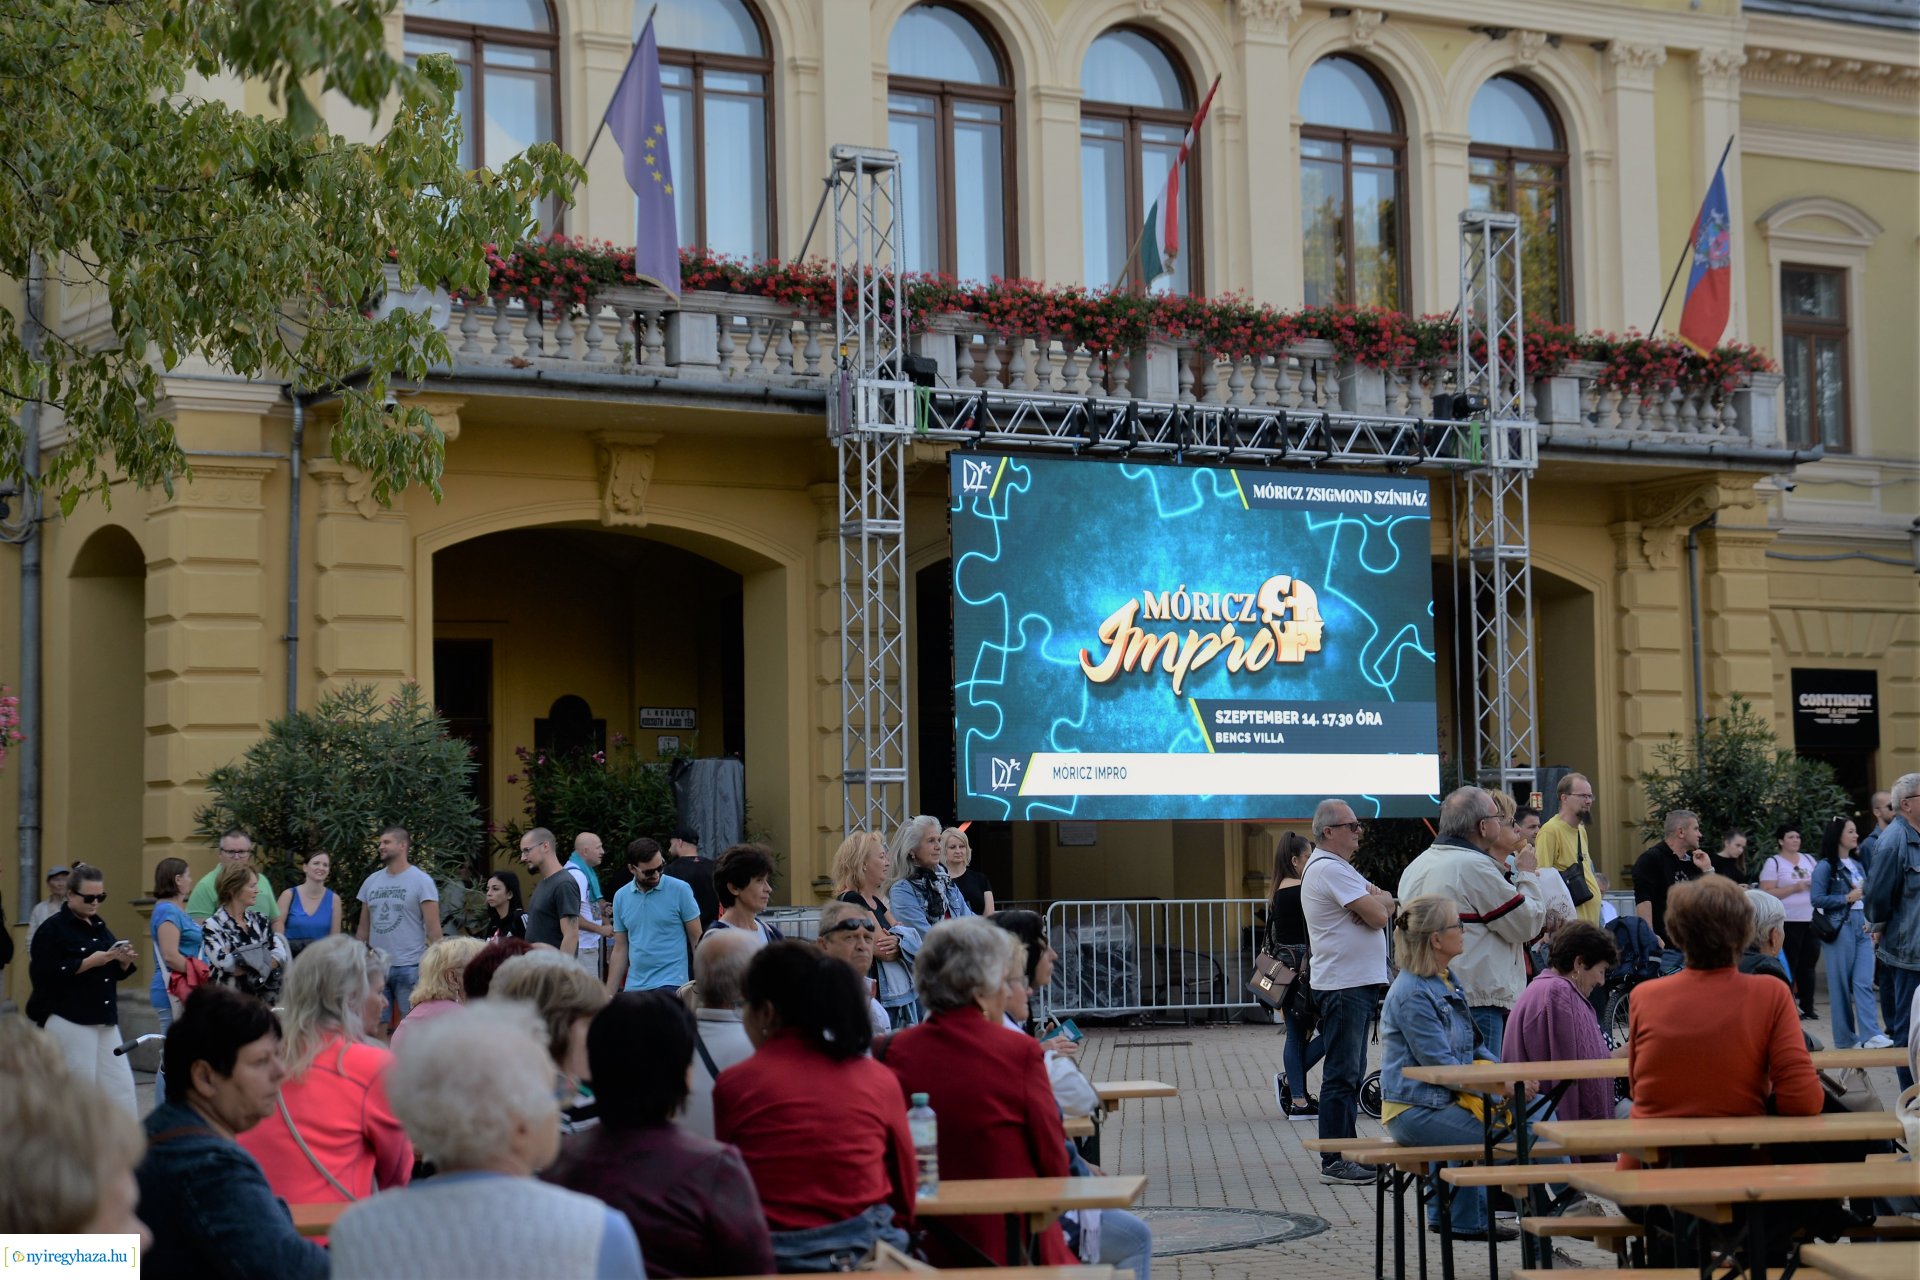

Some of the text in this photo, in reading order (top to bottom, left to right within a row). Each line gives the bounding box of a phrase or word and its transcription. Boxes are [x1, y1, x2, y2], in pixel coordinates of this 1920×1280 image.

[1253, 482, 1428, 507] MÓRICZ ZSIGMOND SZÍNHÁZ
[1142, 584, 1257, 622] MÓRICZ
[1078, 598, 1276, 696] Impro
[1799, 693, 1872, 707] CONTINENT
[1215, 709, 1383, 727] SZEPTEMBER 14. 17.30 ÓRA
[1215, 732, 1285, 744] BENCS VILLA
[1095, 766, 1127, 780] IMPRO
[368, 888, 407, 901] CAMPING
